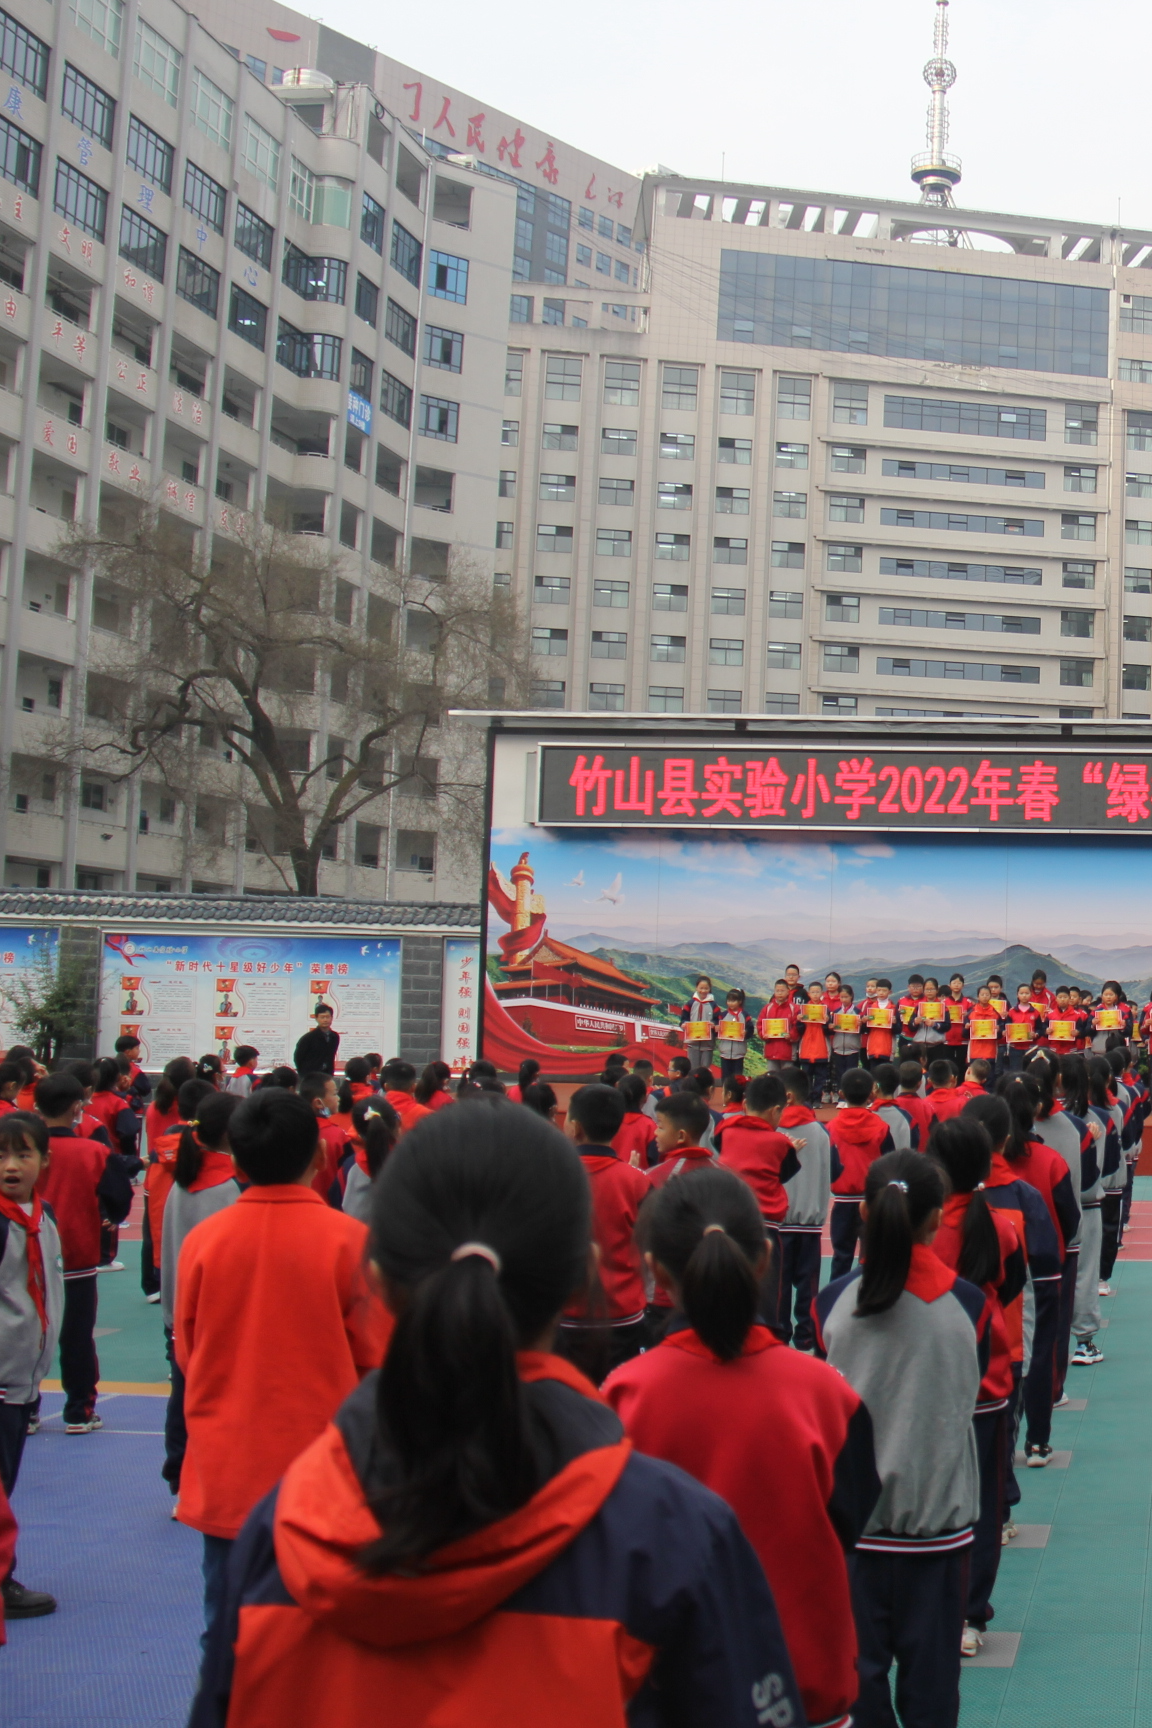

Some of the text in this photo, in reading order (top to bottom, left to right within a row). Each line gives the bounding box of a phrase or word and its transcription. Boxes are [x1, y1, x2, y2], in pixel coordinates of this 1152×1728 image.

[57, 223, 94, 267] 文明
[5, 292, 17, 320] 由
[51, 319, 87, 362] 平等
[116, 360, 148, 393] 公正
[43, 420, 78, 456] 爱国
[107, 450, 141, 483] 敬业
[569, 755, 1060, 822] 竹山县实验小学2022年春
[3, 952, 15, 964] 榜
[310, 963, 349, 975] 荣誉榜
[458, 956, 473, 998] 少年强
